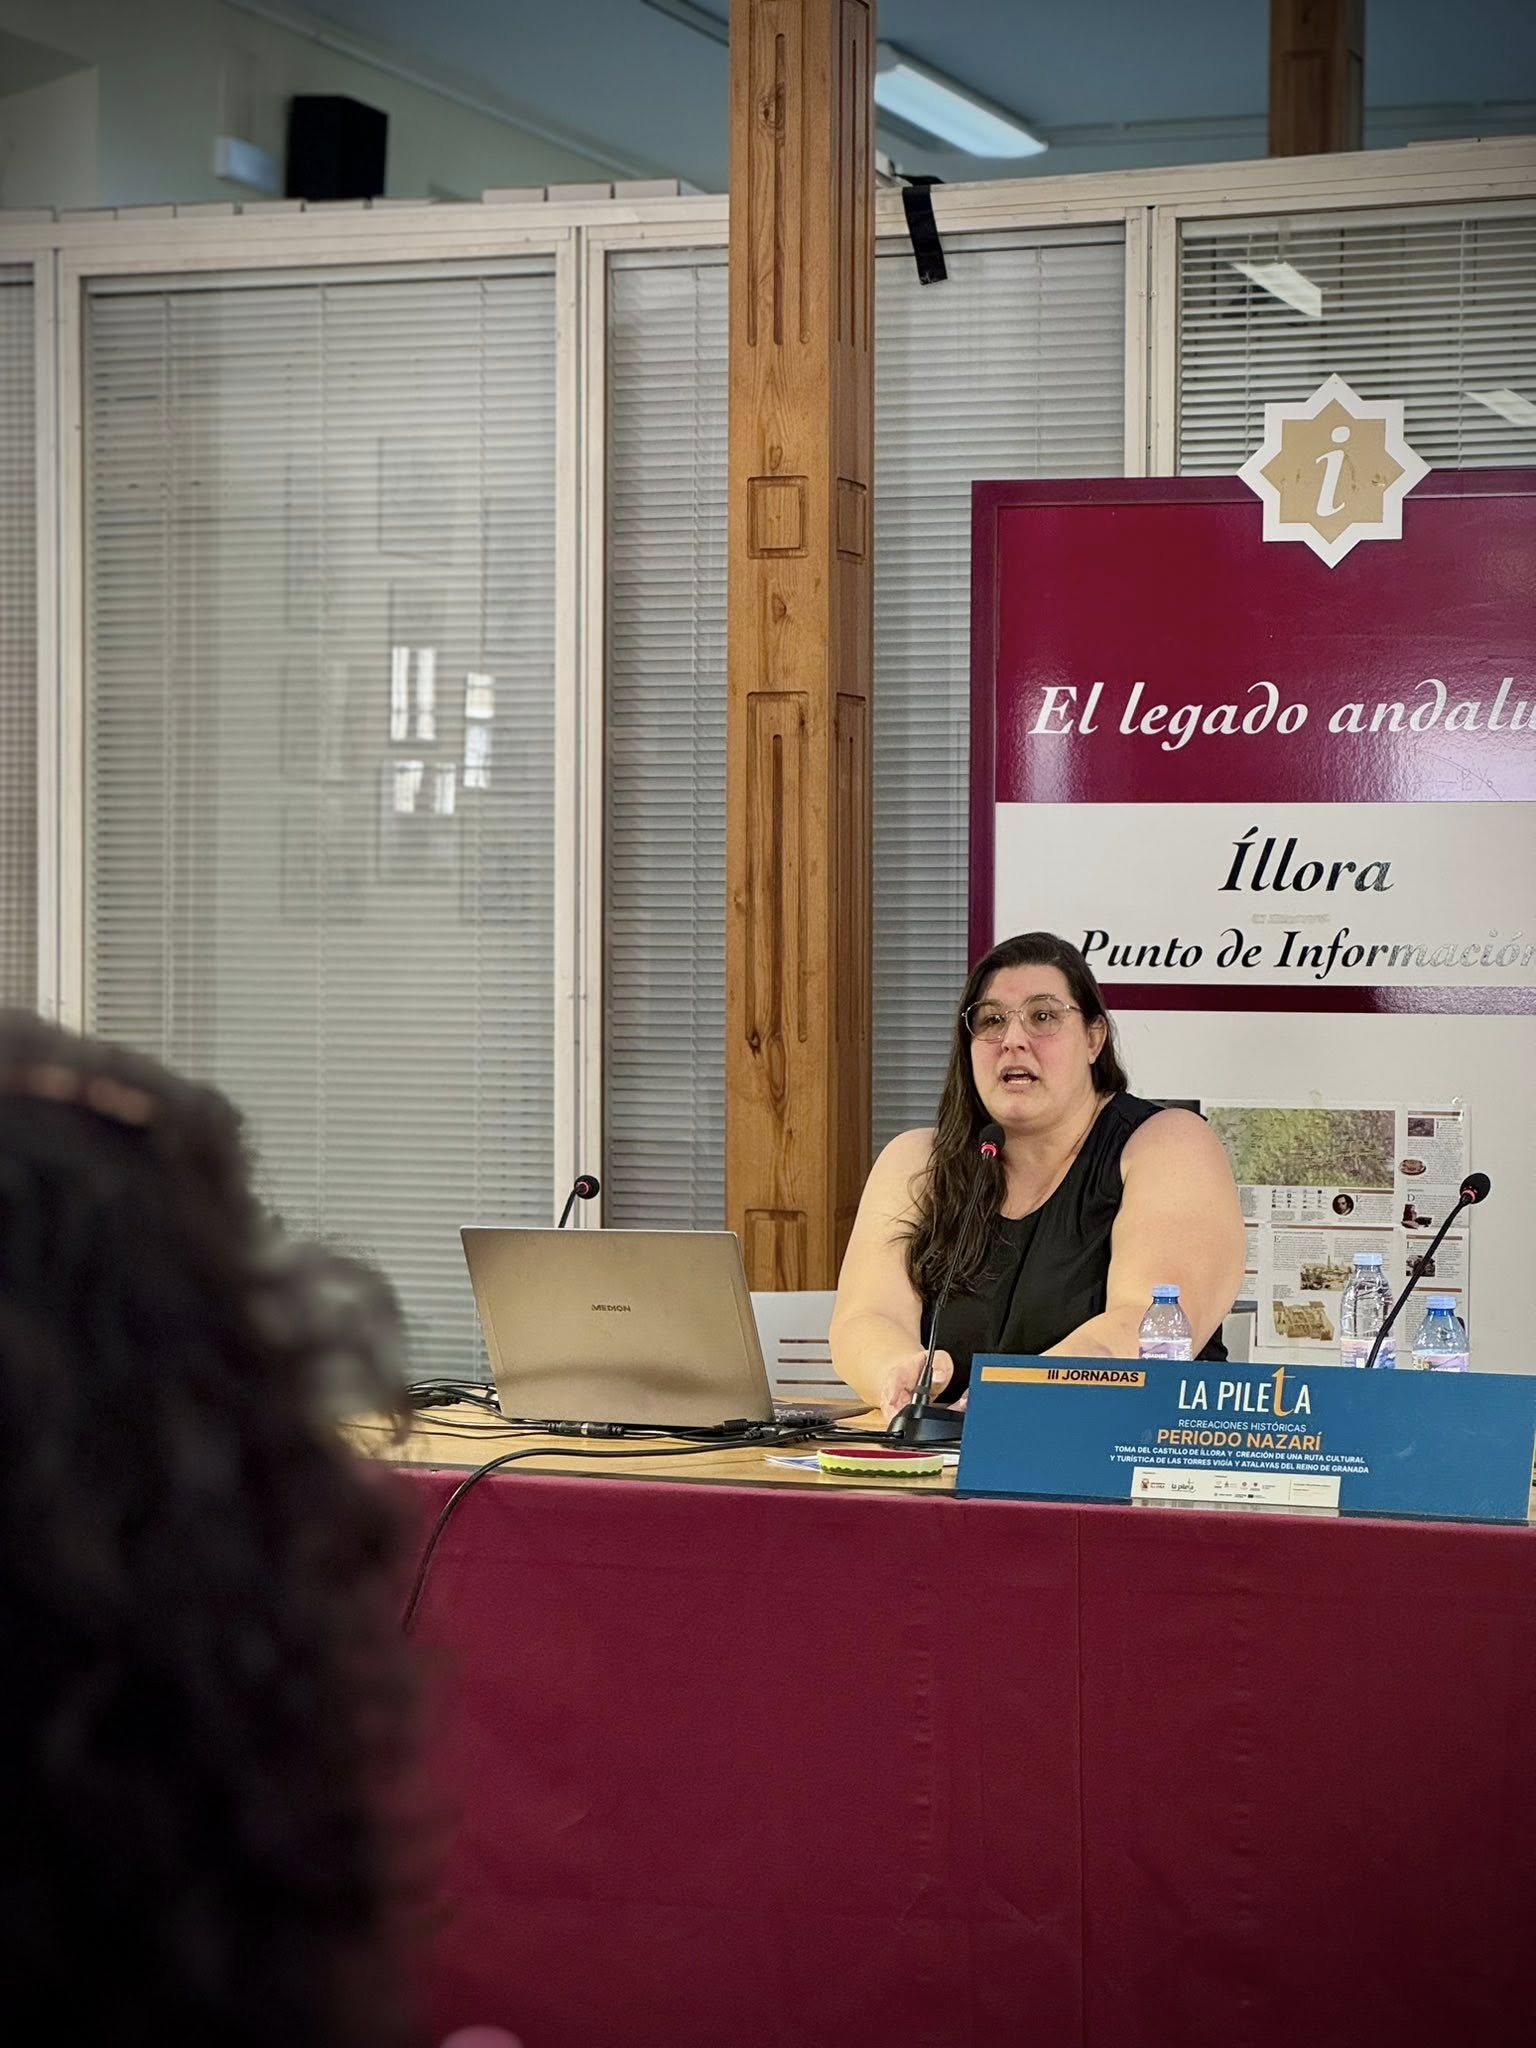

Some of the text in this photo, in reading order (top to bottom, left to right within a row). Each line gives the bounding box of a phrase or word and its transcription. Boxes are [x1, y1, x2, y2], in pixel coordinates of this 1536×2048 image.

[1028, 682, 1104, 735] El
[1119, 681, 1309, 751] legado
[1217, 826, 1395, 892] Íllora
[1081, 929, 1203, 968] Punto
[1217, 928, 1262, 968] de
[591, 1304, 632, 1312] MEDION
[1047, 1369, 1139, 1383] III JORNADAS
[1178, 1379, 1208, 1410] LA
[1178, 1419, 1307, 1433] RECREACIONES HISTÓRICAS
[1157, 1429, 1323, 1451] PERIODO NAZARÍ
[1114, 1445, 1136, 1453] TOMA
[1152, 1447, 1188, 1455] CASTILLO
[1200, 1448, 1226, 1457] ÍLLORA
[1235, 1450, 1274, 1459] CREACIÓN
[1275, 1452, 1285, 1460] DE
[1325, 1455, 1365, 1463] CULTURAL
[1117, 1454, 1155, 1463] TURÍSTICA
[1183, 1458, 1211, 1466] TORRES
[1213, 1458, 1233, 1467] VIGÍA
[1241, 1461, 1279, 1469] ATALAYAS
[1281, 1462, 1295, 1470] DEL
[1296, 1463, 1318, 1471] REINO
[1331, 1465, 1369, 1473] GRANADA
